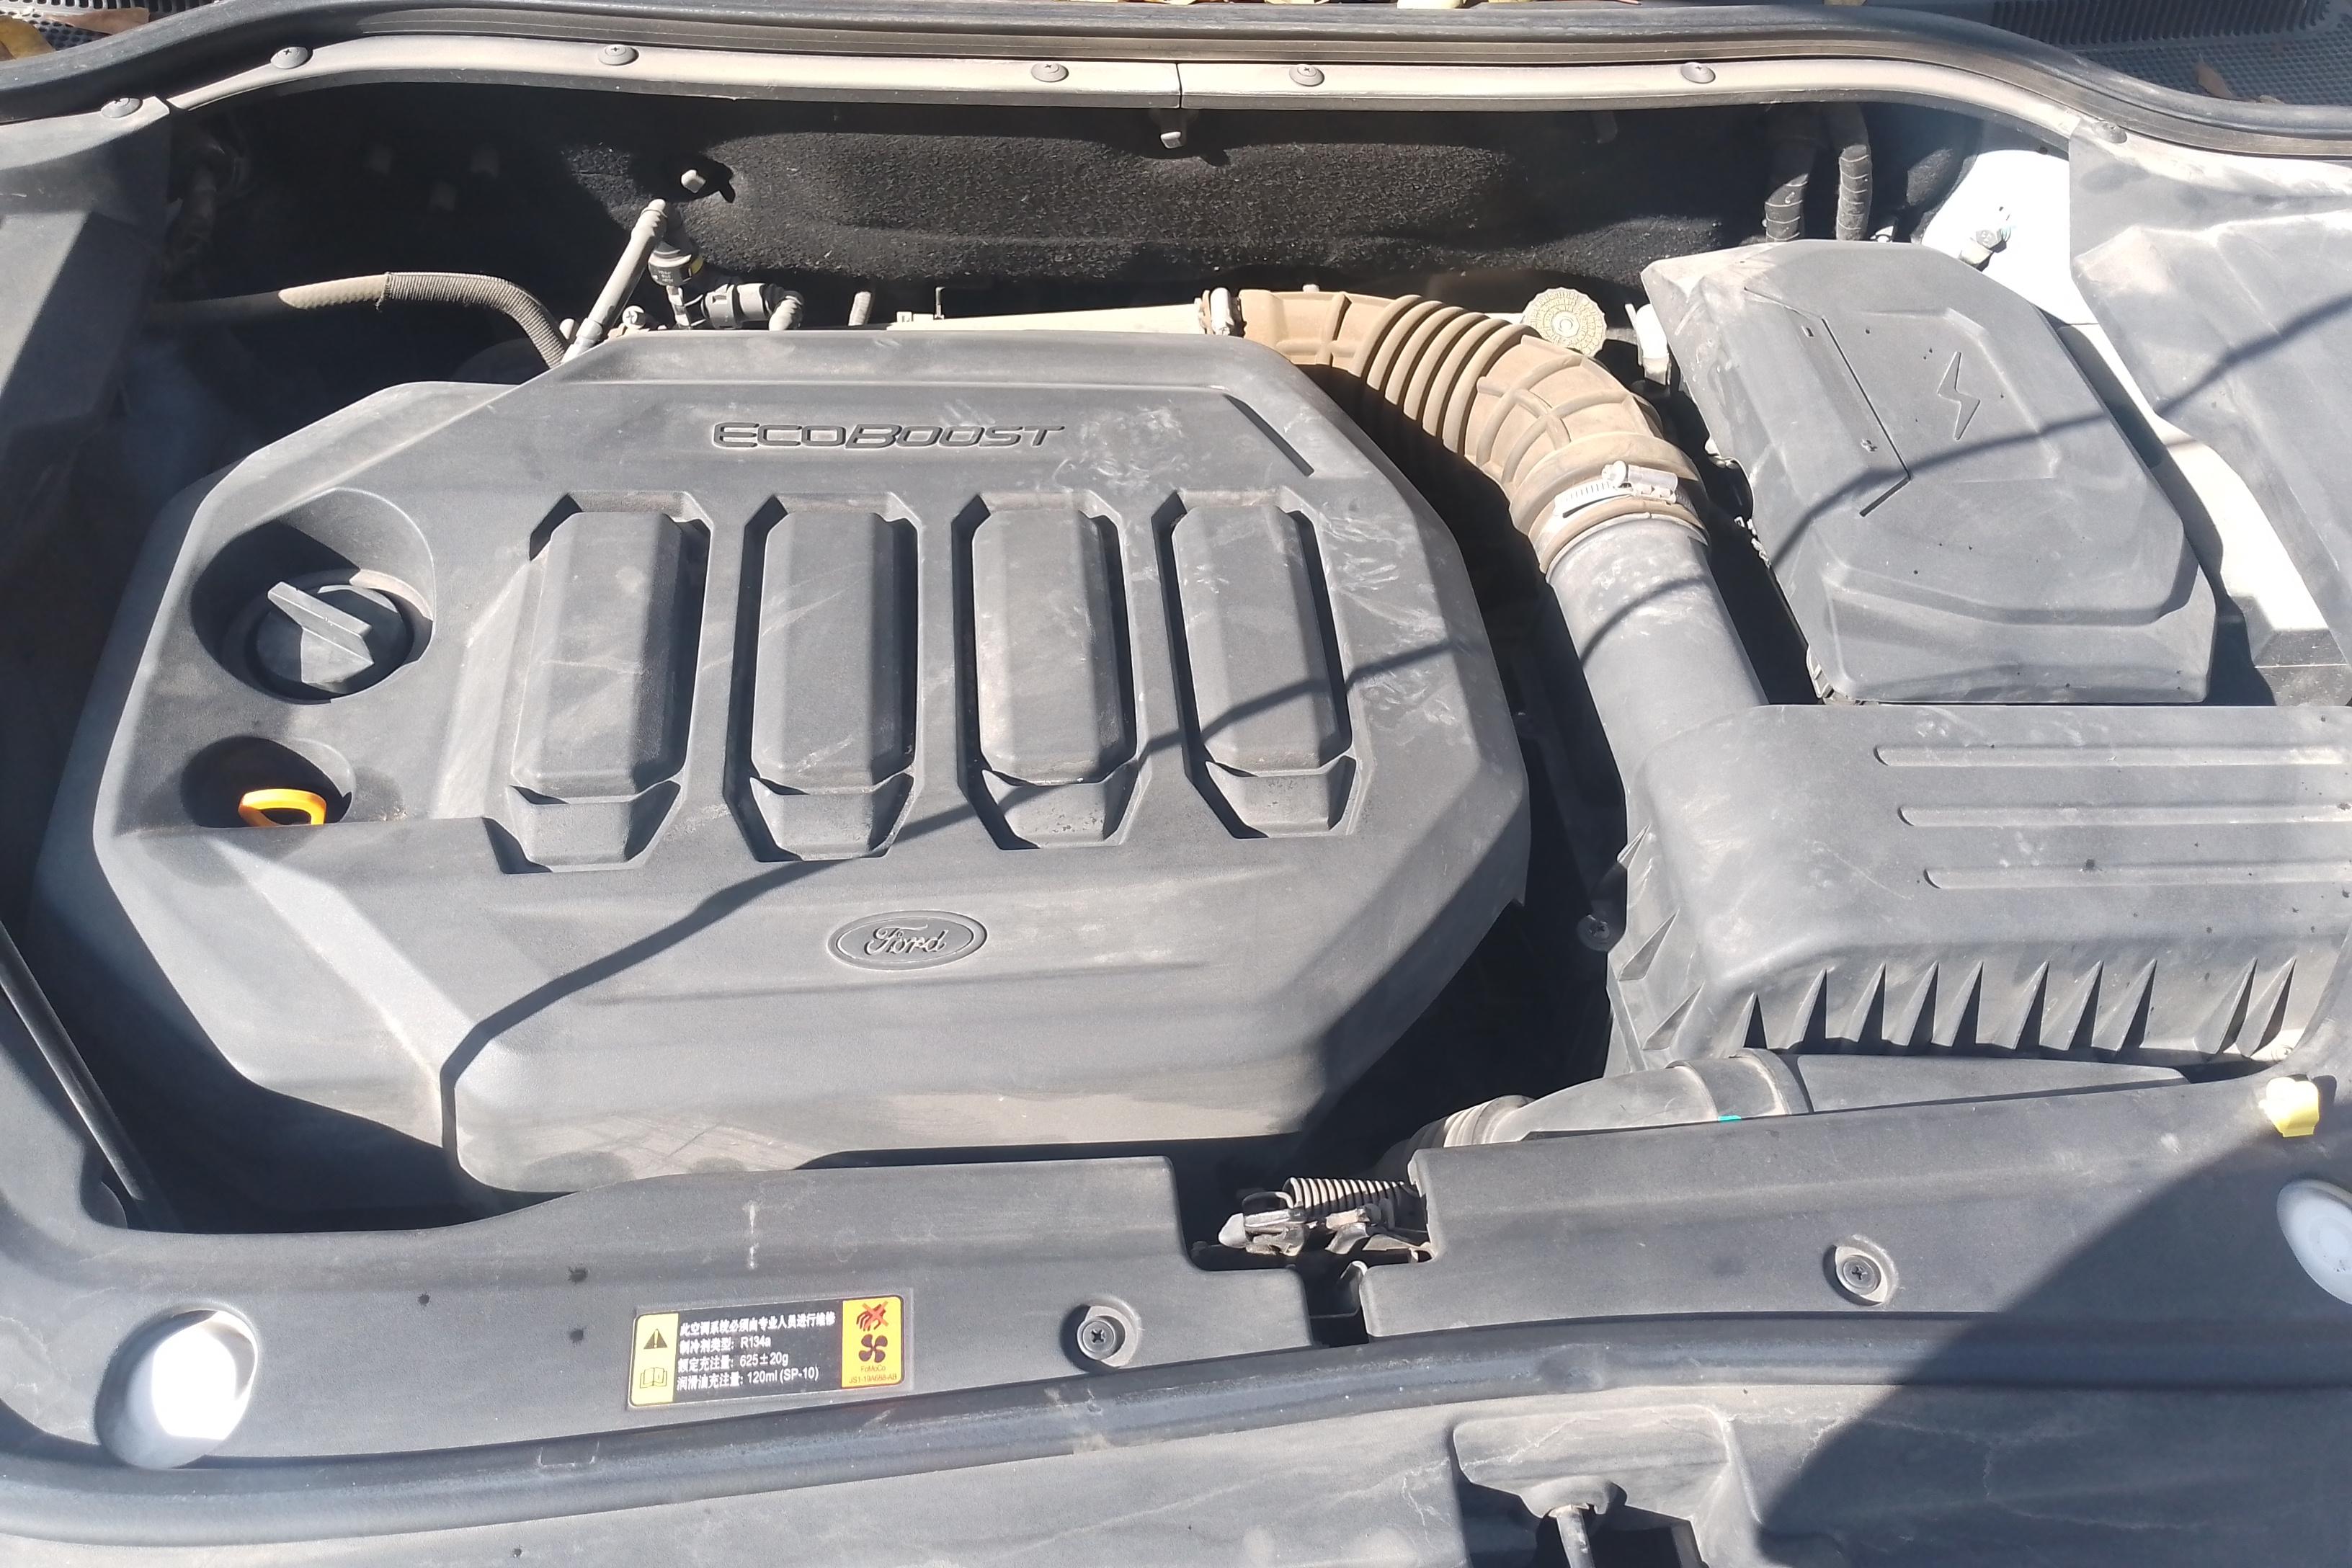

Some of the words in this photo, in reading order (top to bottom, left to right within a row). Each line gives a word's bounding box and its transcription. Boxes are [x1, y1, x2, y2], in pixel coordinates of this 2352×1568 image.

[864, 924, 949, 956] Ford
[740, 1335, 772, 1349] R134a
[739, 1352, 789, 1368] 625±20g
